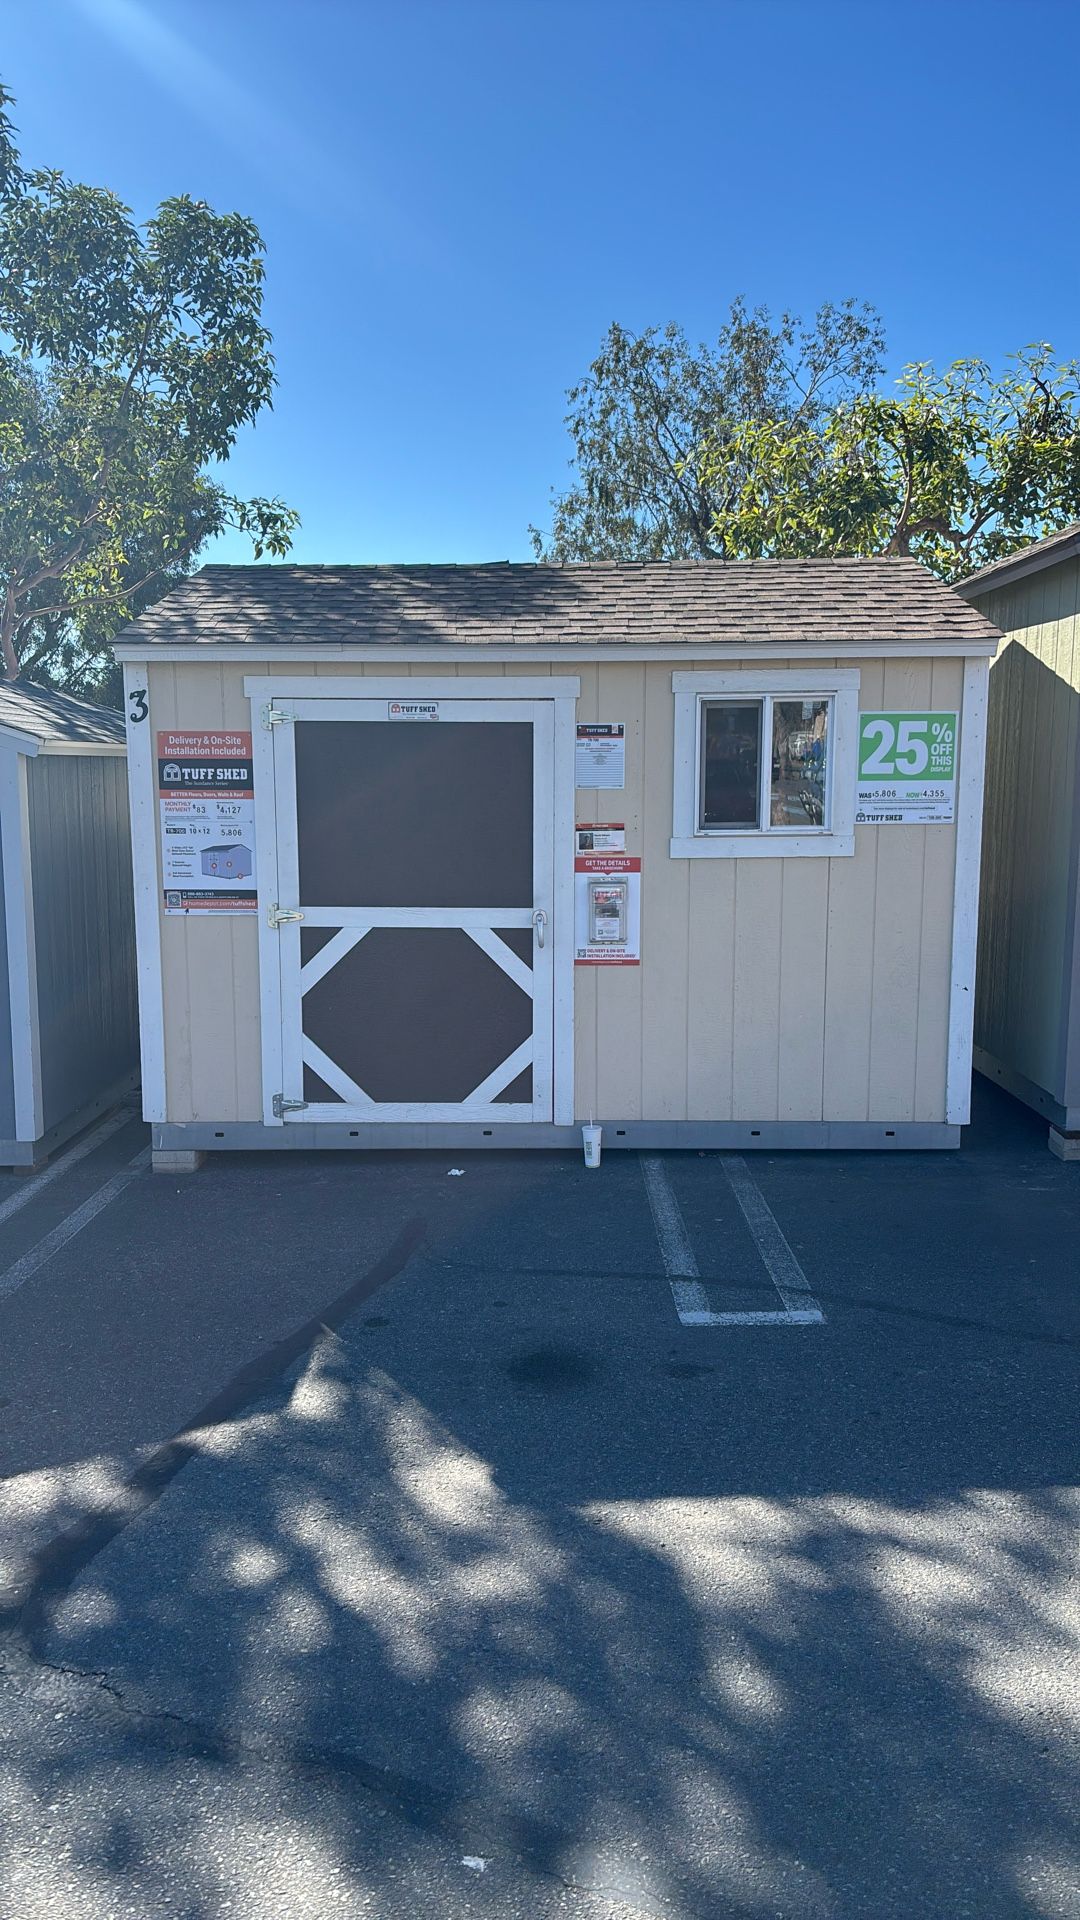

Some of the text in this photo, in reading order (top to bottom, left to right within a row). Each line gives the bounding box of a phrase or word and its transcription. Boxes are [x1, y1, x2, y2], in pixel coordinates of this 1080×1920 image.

[129, 689, 149, 723] 3
[168, 736, 242, 746] Delivery & On-Site
[164, 746, 246, 755] Installation Included
[930, 743, 953, 755] OFF
[930, 756, 952, 765] THIS
[182, 768, 248, 780] TUFF SHED
